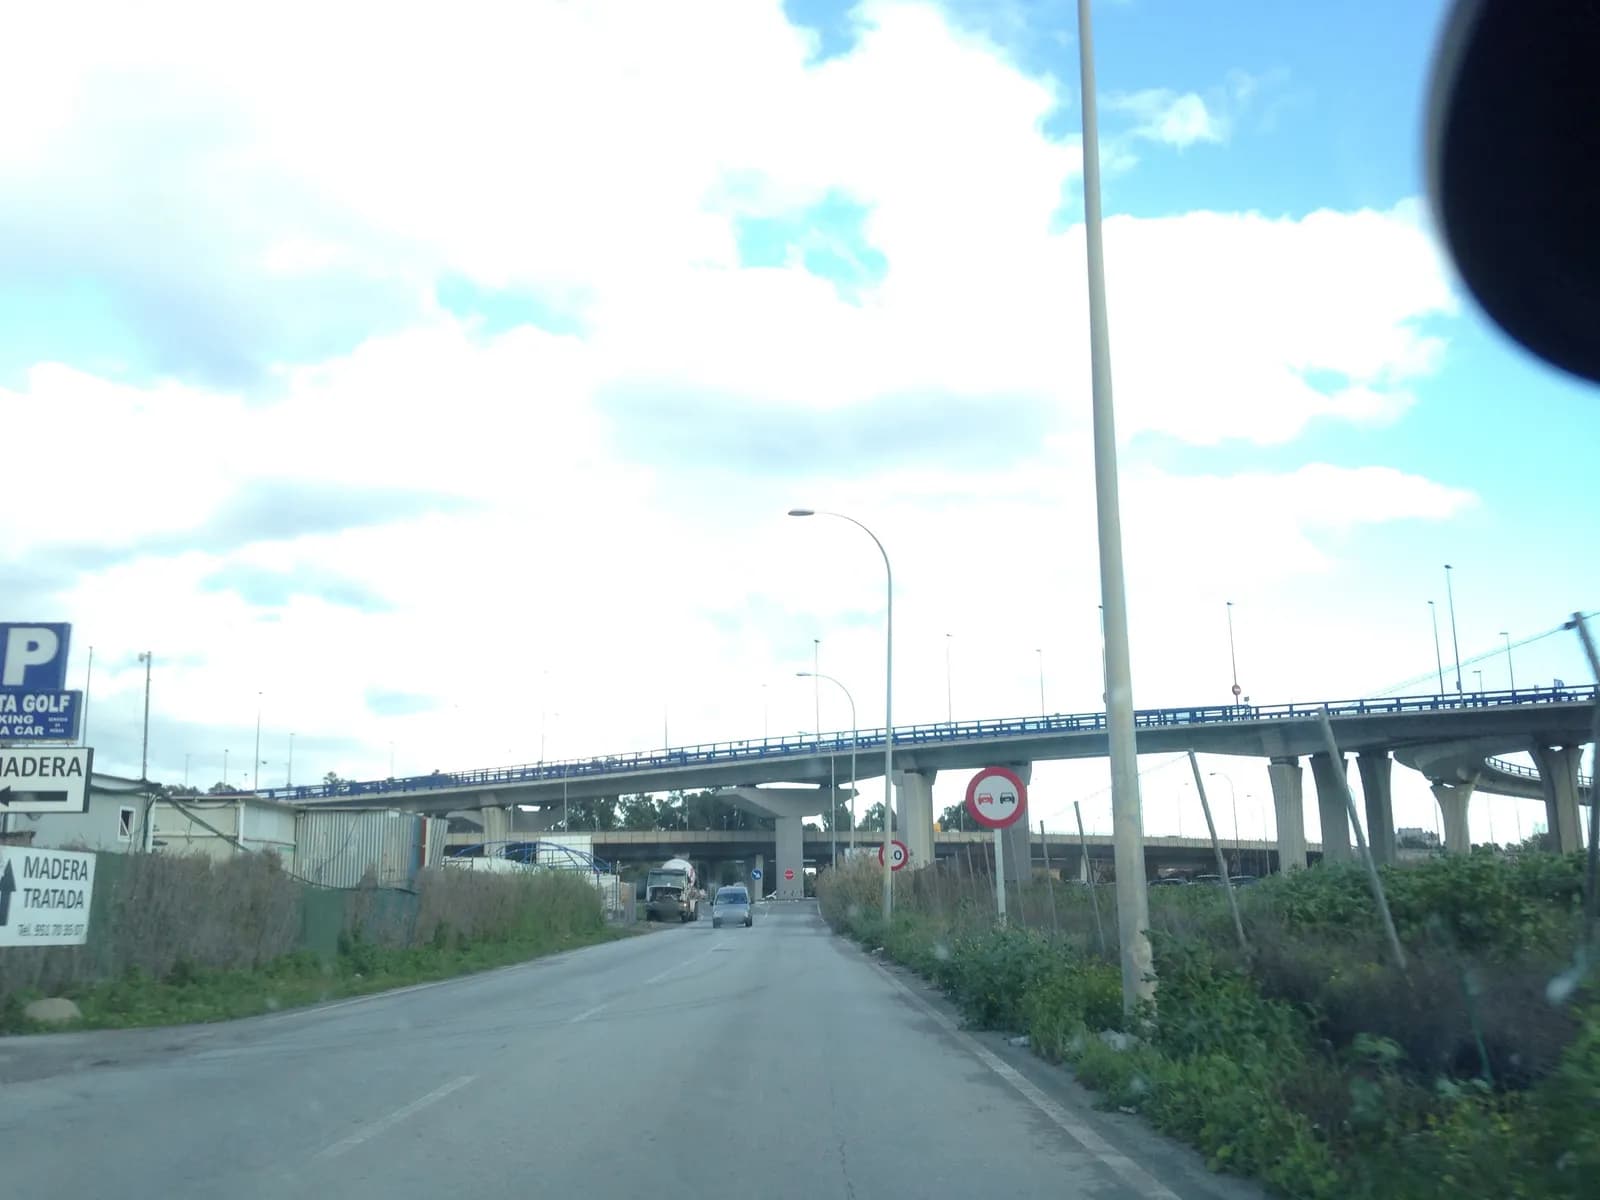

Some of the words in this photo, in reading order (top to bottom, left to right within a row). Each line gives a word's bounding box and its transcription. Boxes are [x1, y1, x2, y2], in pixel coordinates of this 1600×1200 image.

[2, 627, 59, 686] P
[22, 694, 71, 713] GOLF
[14, 725, 44, 735] CAR
[23, 855, 88, 881] MADERA
[23, 887, 84, 909] TRATADA
